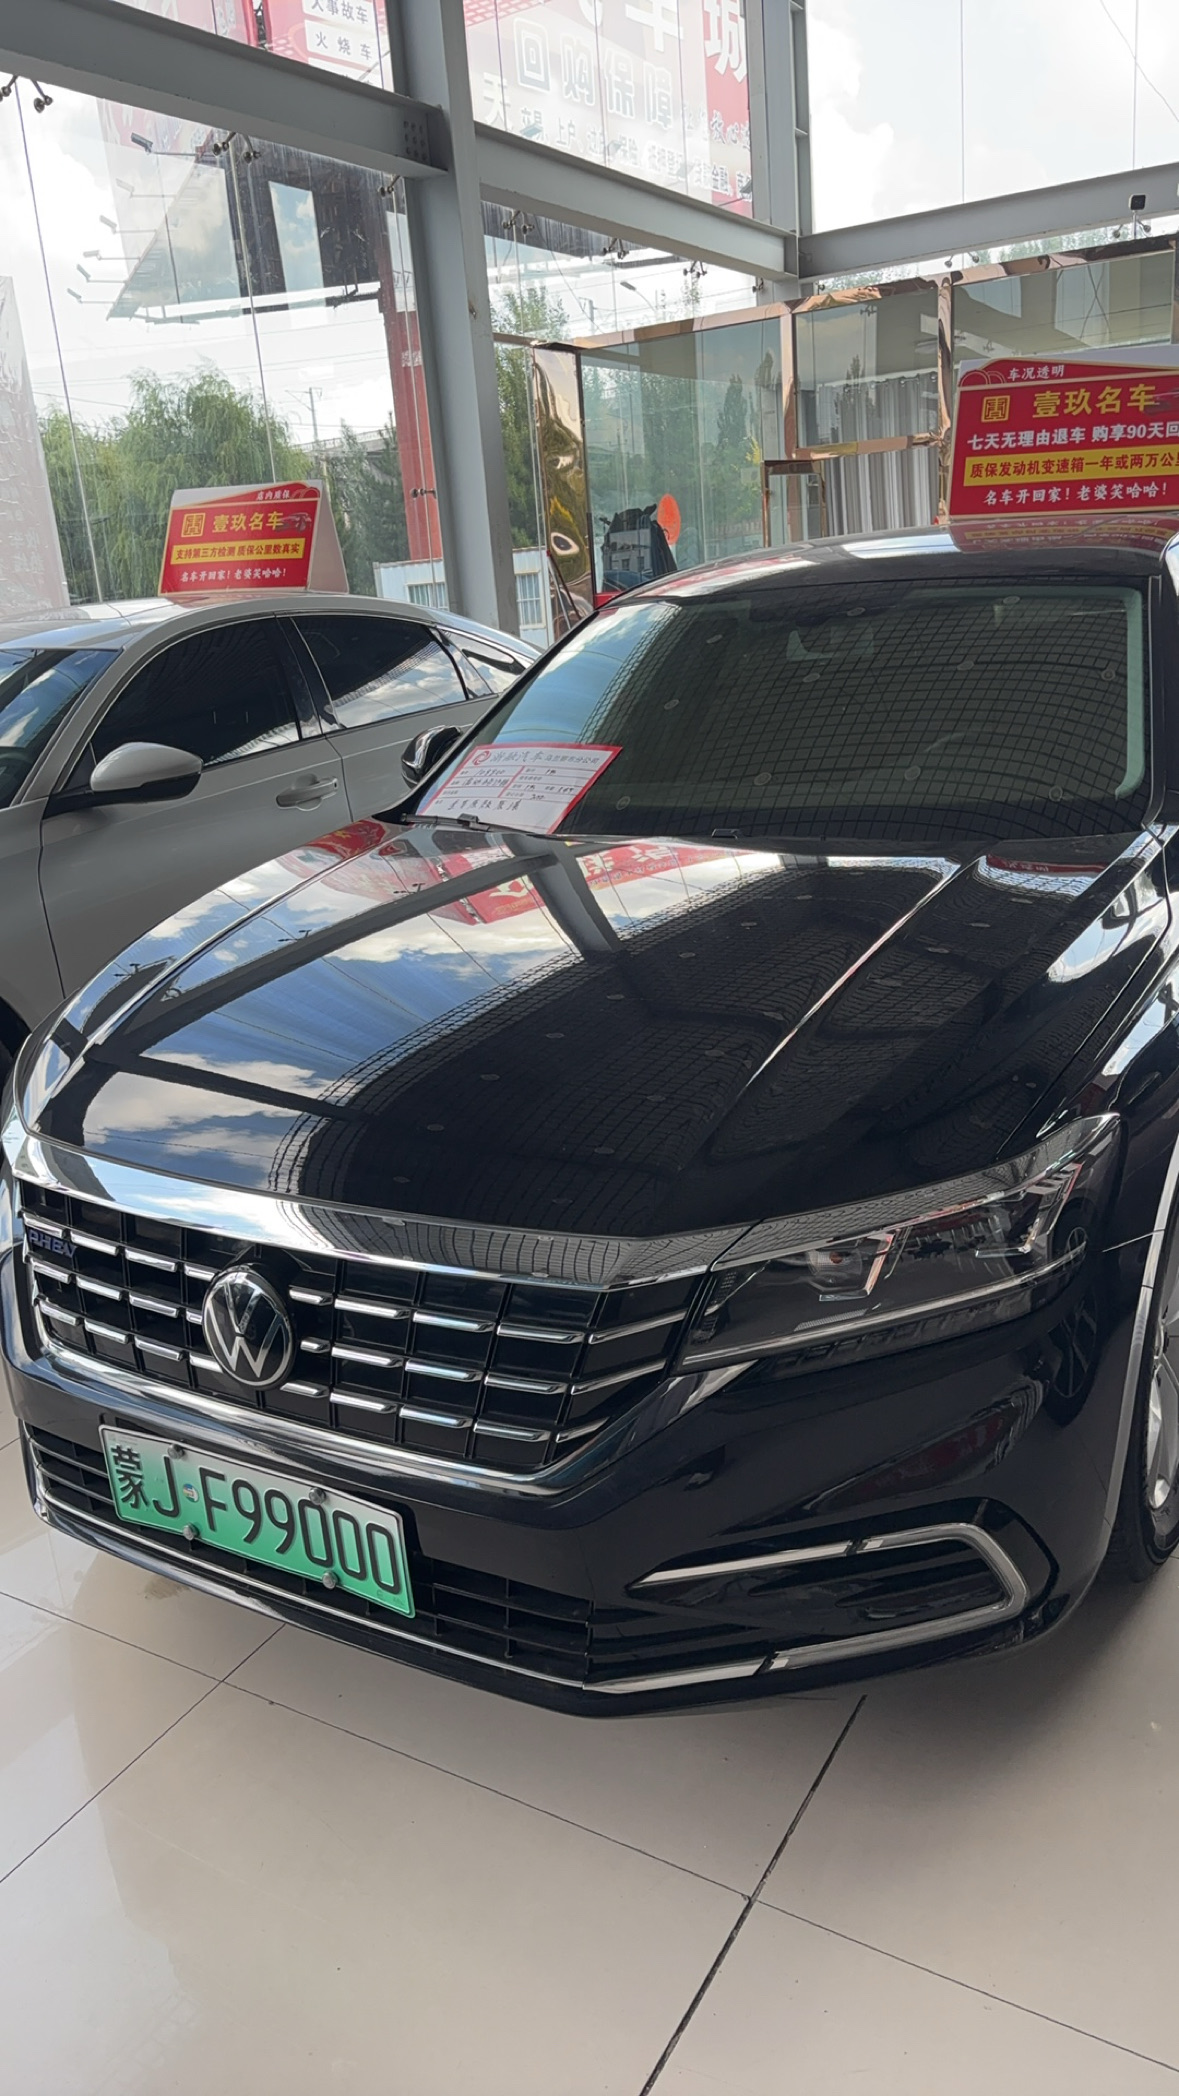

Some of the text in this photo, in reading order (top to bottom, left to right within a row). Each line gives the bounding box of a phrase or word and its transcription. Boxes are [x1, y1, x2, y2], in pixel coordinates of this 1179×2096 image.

[1007, 364, 1065, 381] 车况透明
[1032, 384, 1160, 419] 壹玖名车
[967, 426, 1086, 451] 七天无理由退车
[970, 451, 1179, 479] 质保发动机变速箱一年或两万公
[212, 511, 285, 533] 壹玖名车
[176, 543, 300, 560] 支持第三方检测 质保公里数真实
[28, 1229, 78, 1259] PHEV
